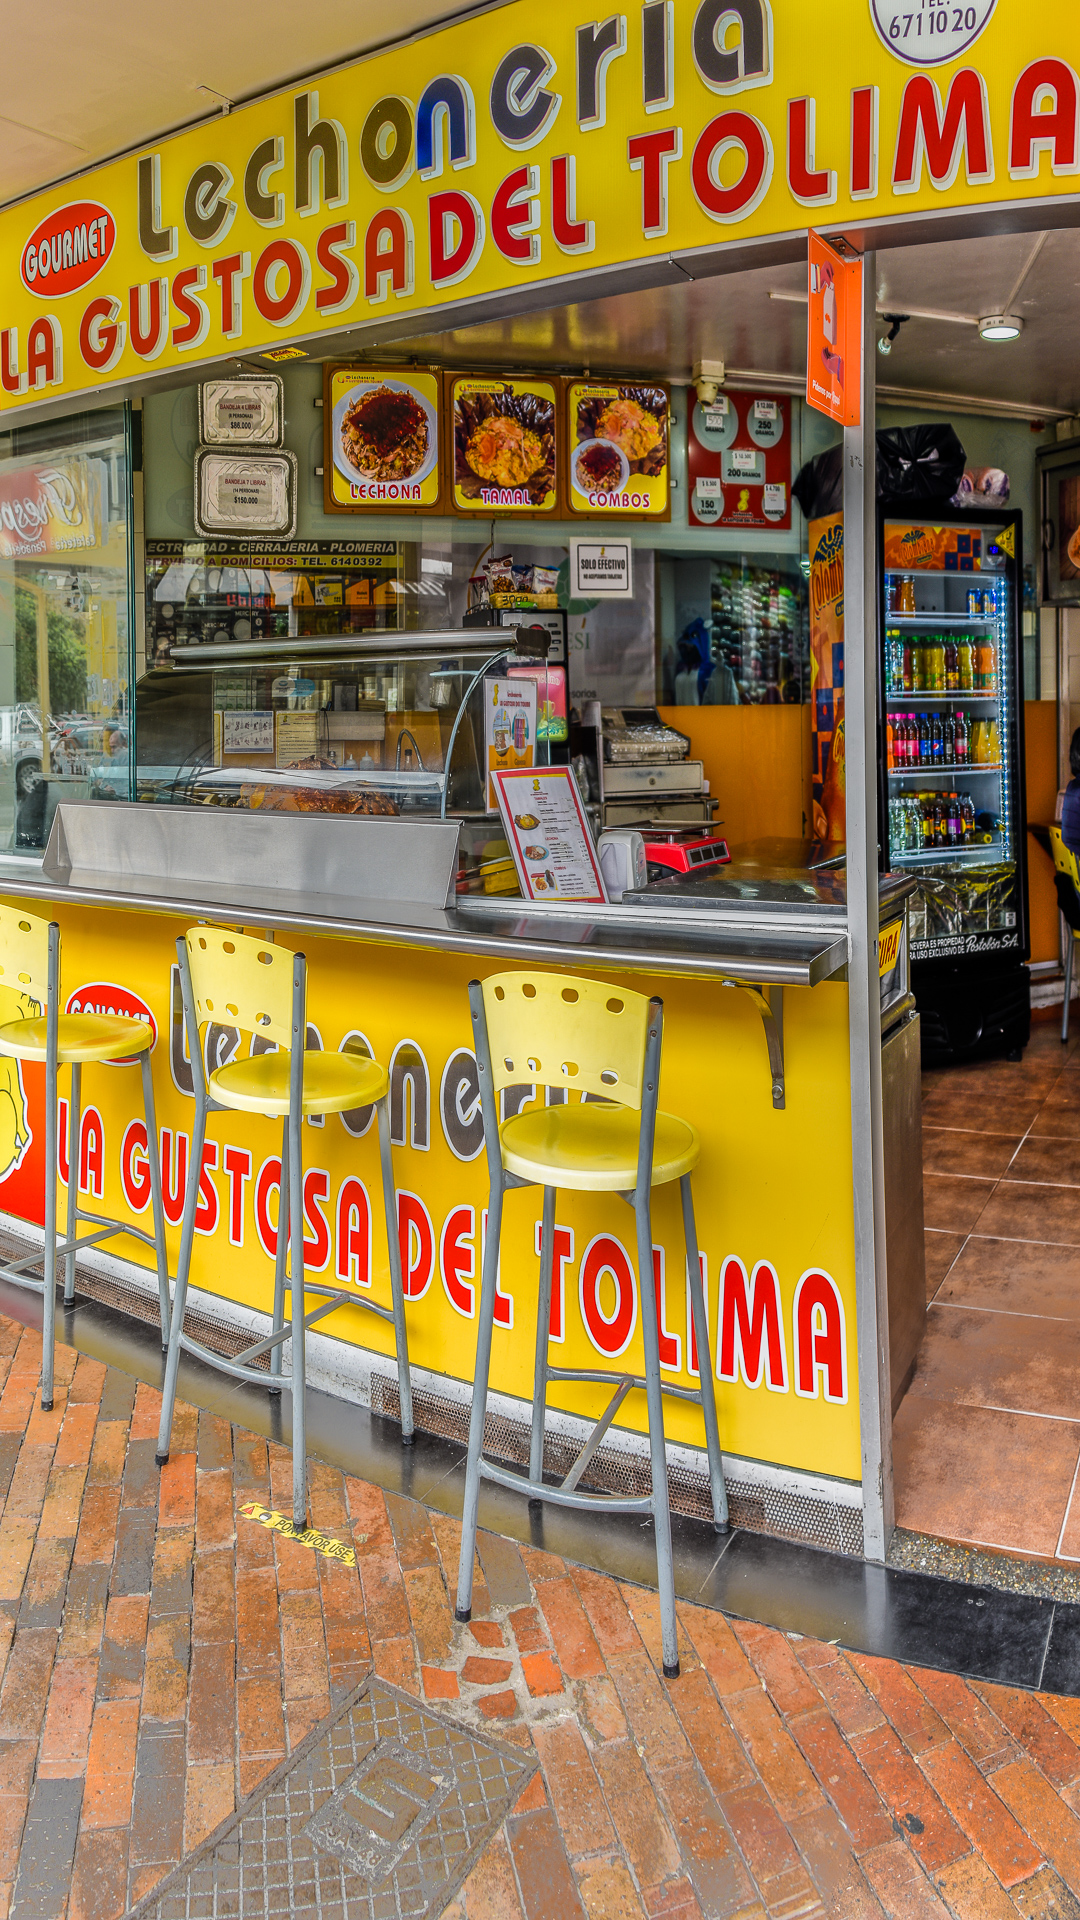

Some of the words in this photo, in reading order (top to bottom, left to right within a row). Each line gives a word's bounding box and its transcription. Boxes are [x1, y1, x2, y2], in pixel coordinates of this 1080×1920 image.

[137, 0, 772, 259] Lechoneria
[0, 315, 60, 393] LA
[79, 206, 413, 373] GUSTOSA
[428, 154, 592, 287] DEL
[628, 56, 1080, 236] TOLIMA
[25, 216, 109, 281] GOURMET
[219, 403, 241, 411] BANDEJA
[758, 420, 772, 430] 250
[754, 429, 775, 437] GRAMOS
[727, 468, 741, 477] 200
[249, 479, 267, 487] LIBRAS
[350, 483, 422, 500] LECHONA
[480, 488, 532, 506] TAMAL
[233, 496, 259, 505] $150.000
[588, 492, 651, 509] COMBOS
[701, 499, 715, 509] 150
[239, 542, 319, 553] CERRAJERIA
[329, 542, 395, 553] PLOMERIA
[145, 557, 205, 566] SERVICIO
[207, 557, 217, 566] A
[221, 557, 298, 566] DOMICILIOS:
[300, 557, 327, 566] TEL.
[580, 558, 597, 570] SOLO
[597, 558, 626, 570] EFECTIVO
[909, 940, 930, 951] NEVERA
[929, 940, 937, 948] ES
[937, 936, 965, 948] PROPIEDAD
[916, 950, 928, 959] USO
[928, 946, 957, 958] EXCLUSIVO
[957, 945, 965, 954] DE
[328, 1541, 352, 1559] USE
